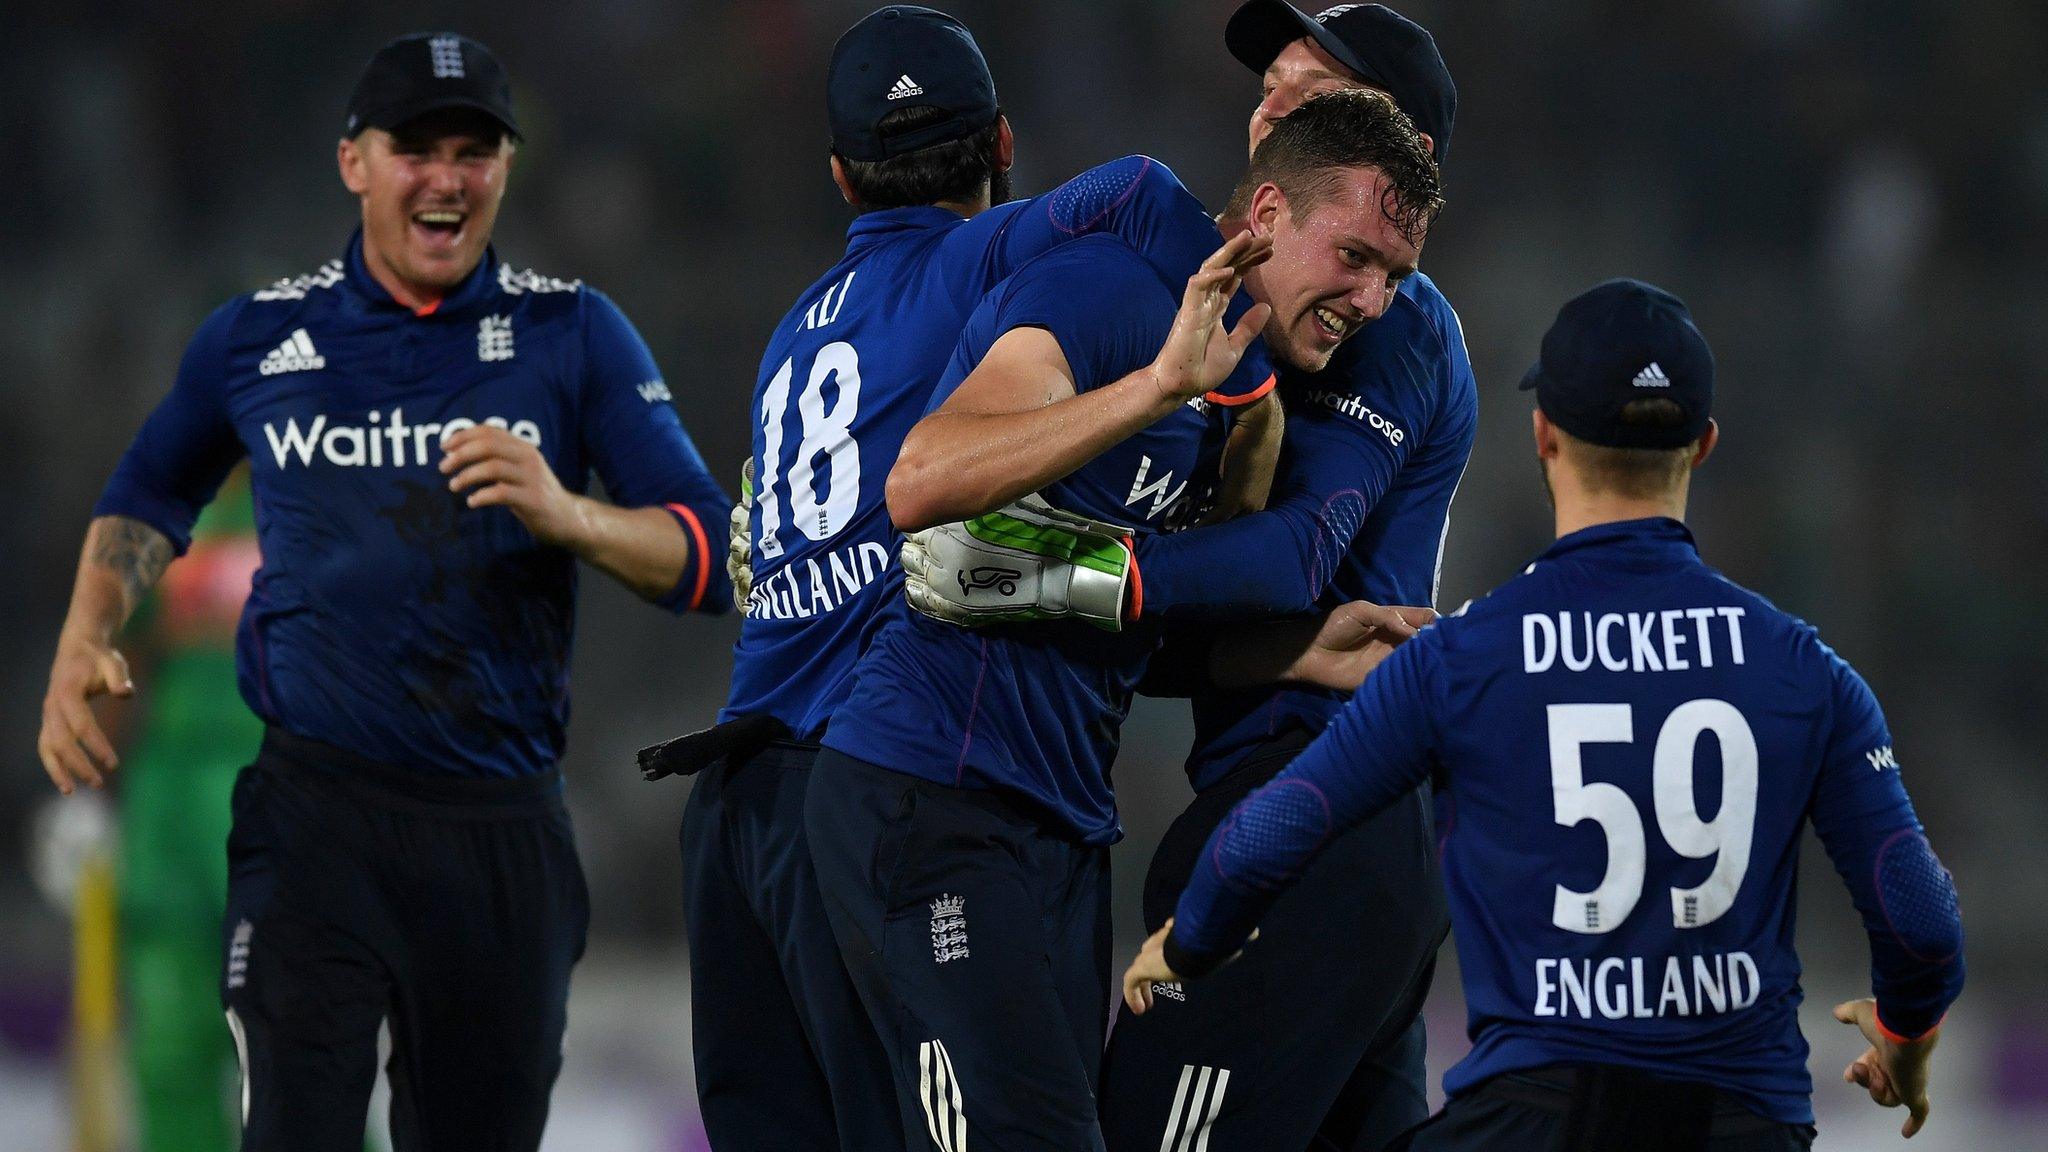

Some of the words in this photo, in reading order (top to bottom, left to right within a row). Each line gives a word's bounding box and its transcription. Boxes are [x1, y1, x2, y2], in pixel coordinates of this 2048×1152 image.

[887, 86, 924, 100] adidas
[757, 341, 862, 560] 18
[1522, 606, 1747, 674] DUCKETT
[1546, 699, 1760, 935] 59
[1534, 951, 1762, 1020] ENGLAND
